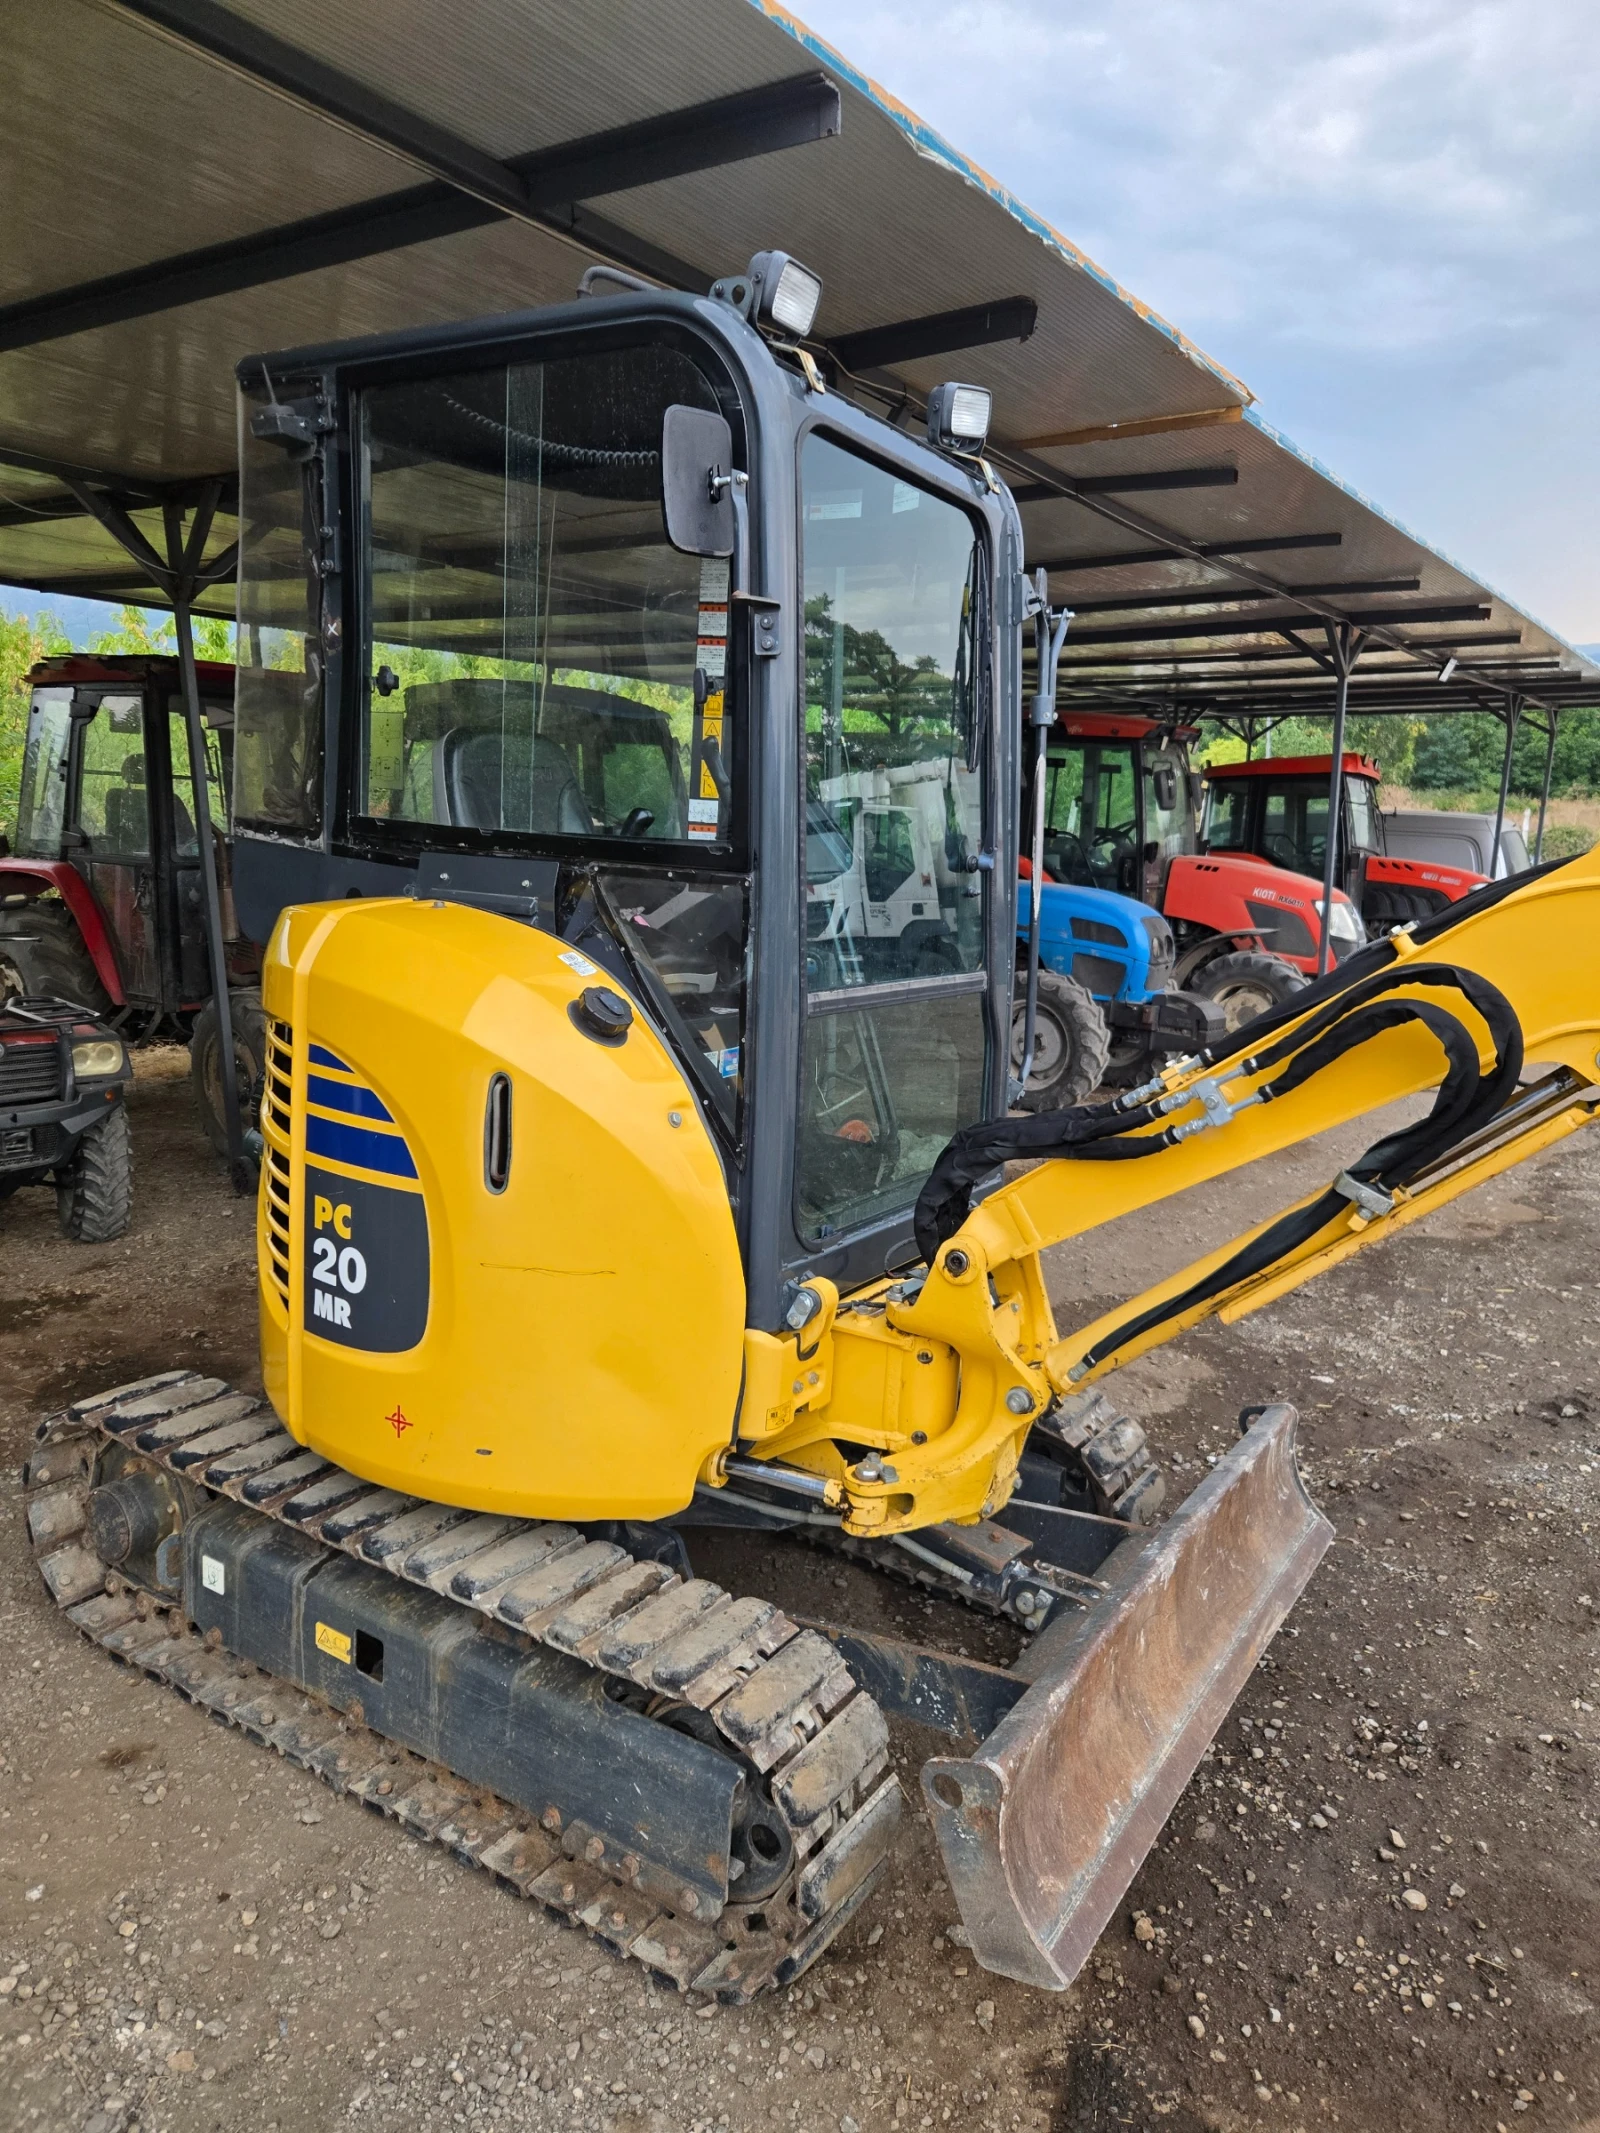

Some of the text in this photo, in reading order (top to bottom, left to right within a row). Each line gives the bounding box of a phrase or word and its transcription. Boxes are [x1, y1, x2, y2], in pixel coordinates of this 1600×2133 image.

[1252, 887, 1277, 901] KIOTI
[314, 1194, 352, 1240] PC
[312, 1237, 367, 1294] 20
[313, 1288, 352, 1329] MR
